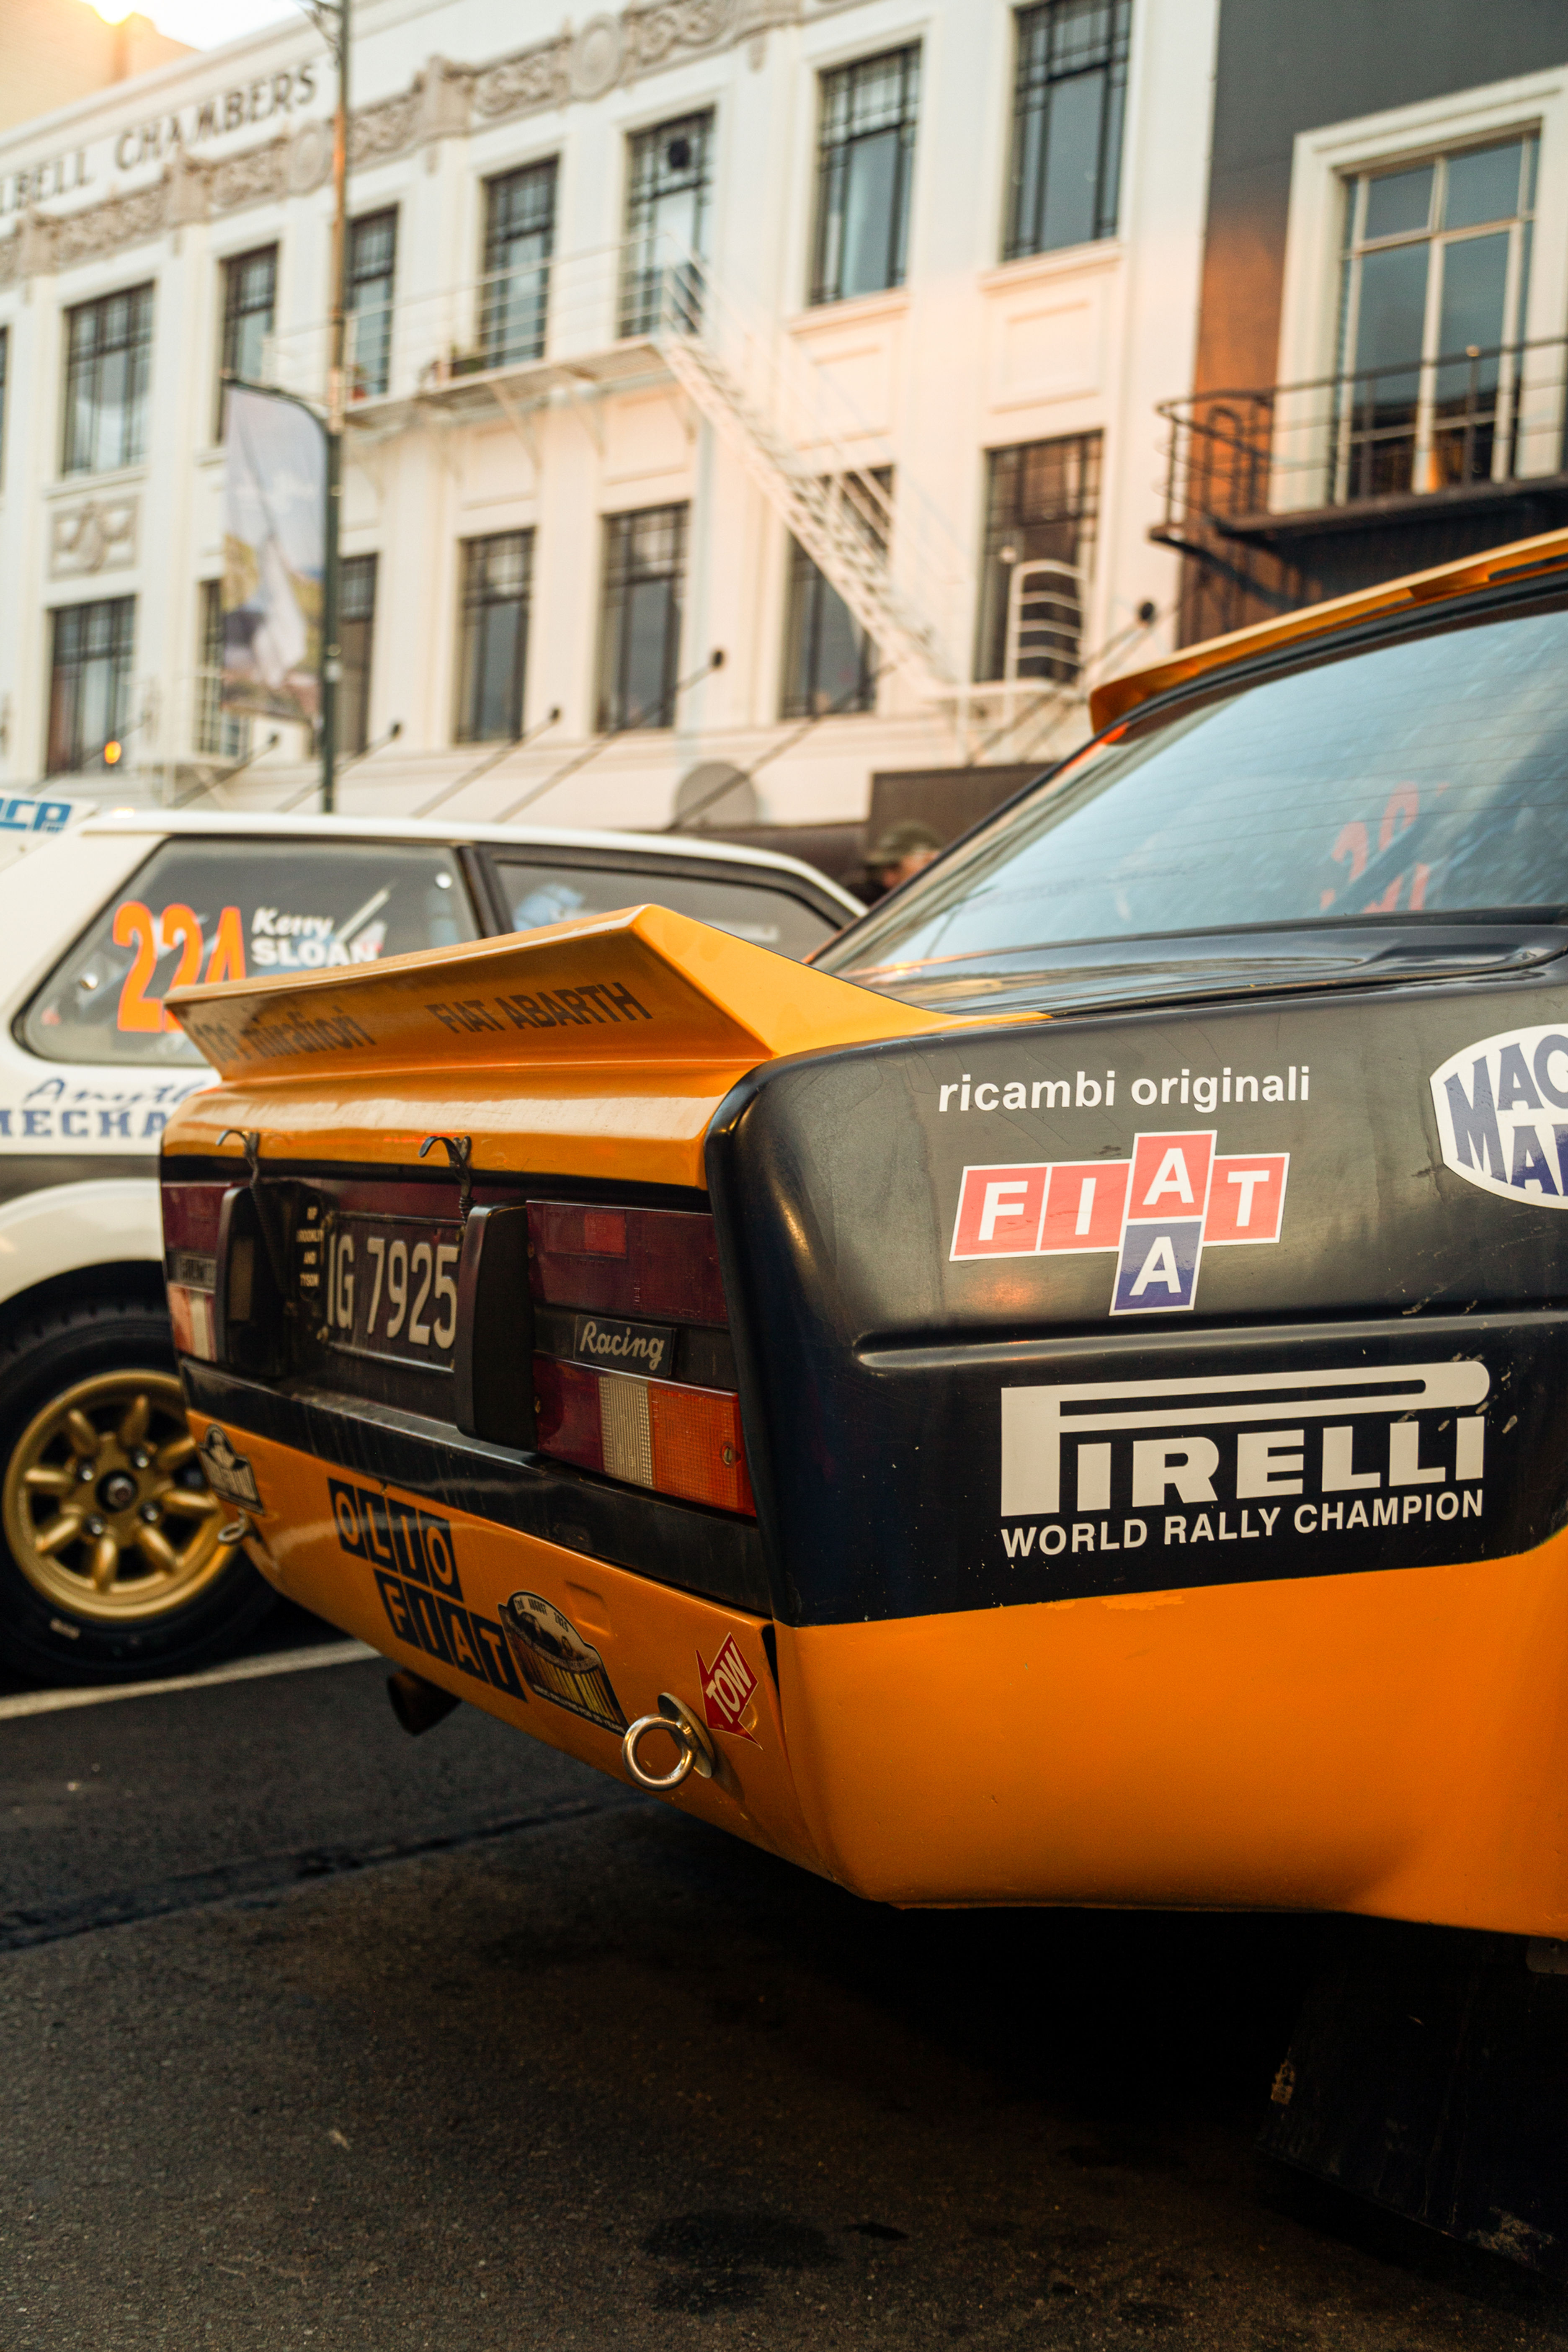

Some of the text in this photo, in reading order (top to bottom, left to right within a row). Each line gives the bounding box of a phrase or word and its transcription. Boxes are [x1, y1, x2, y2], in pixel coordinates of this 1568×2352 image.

[0, 62, 317, 216] BELL CHAMBERS
[0, 798, 71, 831] CP
[252, 906, 335, 941] Kerry
[252, 937, 380, 967] SLOAN
[426, 982, 654, 1034] FIAT ABARTH
[939, 1066, 1310, 1113] ricambi originali
[978, 1148, 1269, 1241] FIAT
[367, 1237, 459, 1349] 7925
[1130, 1237, 1182, 1297] A
[580, 1321, 665, 1370] Racing
[1001, 1360, 1490, 1516] PIRELLI
[335, 1491, 453, 1586] OLIO
[1001, 1489, 1483, 1557] WORLD RALLY CHAMPION
[383, 1583, 508, 1685] FIAT
[705, 1641, 752, 1724] TOW
